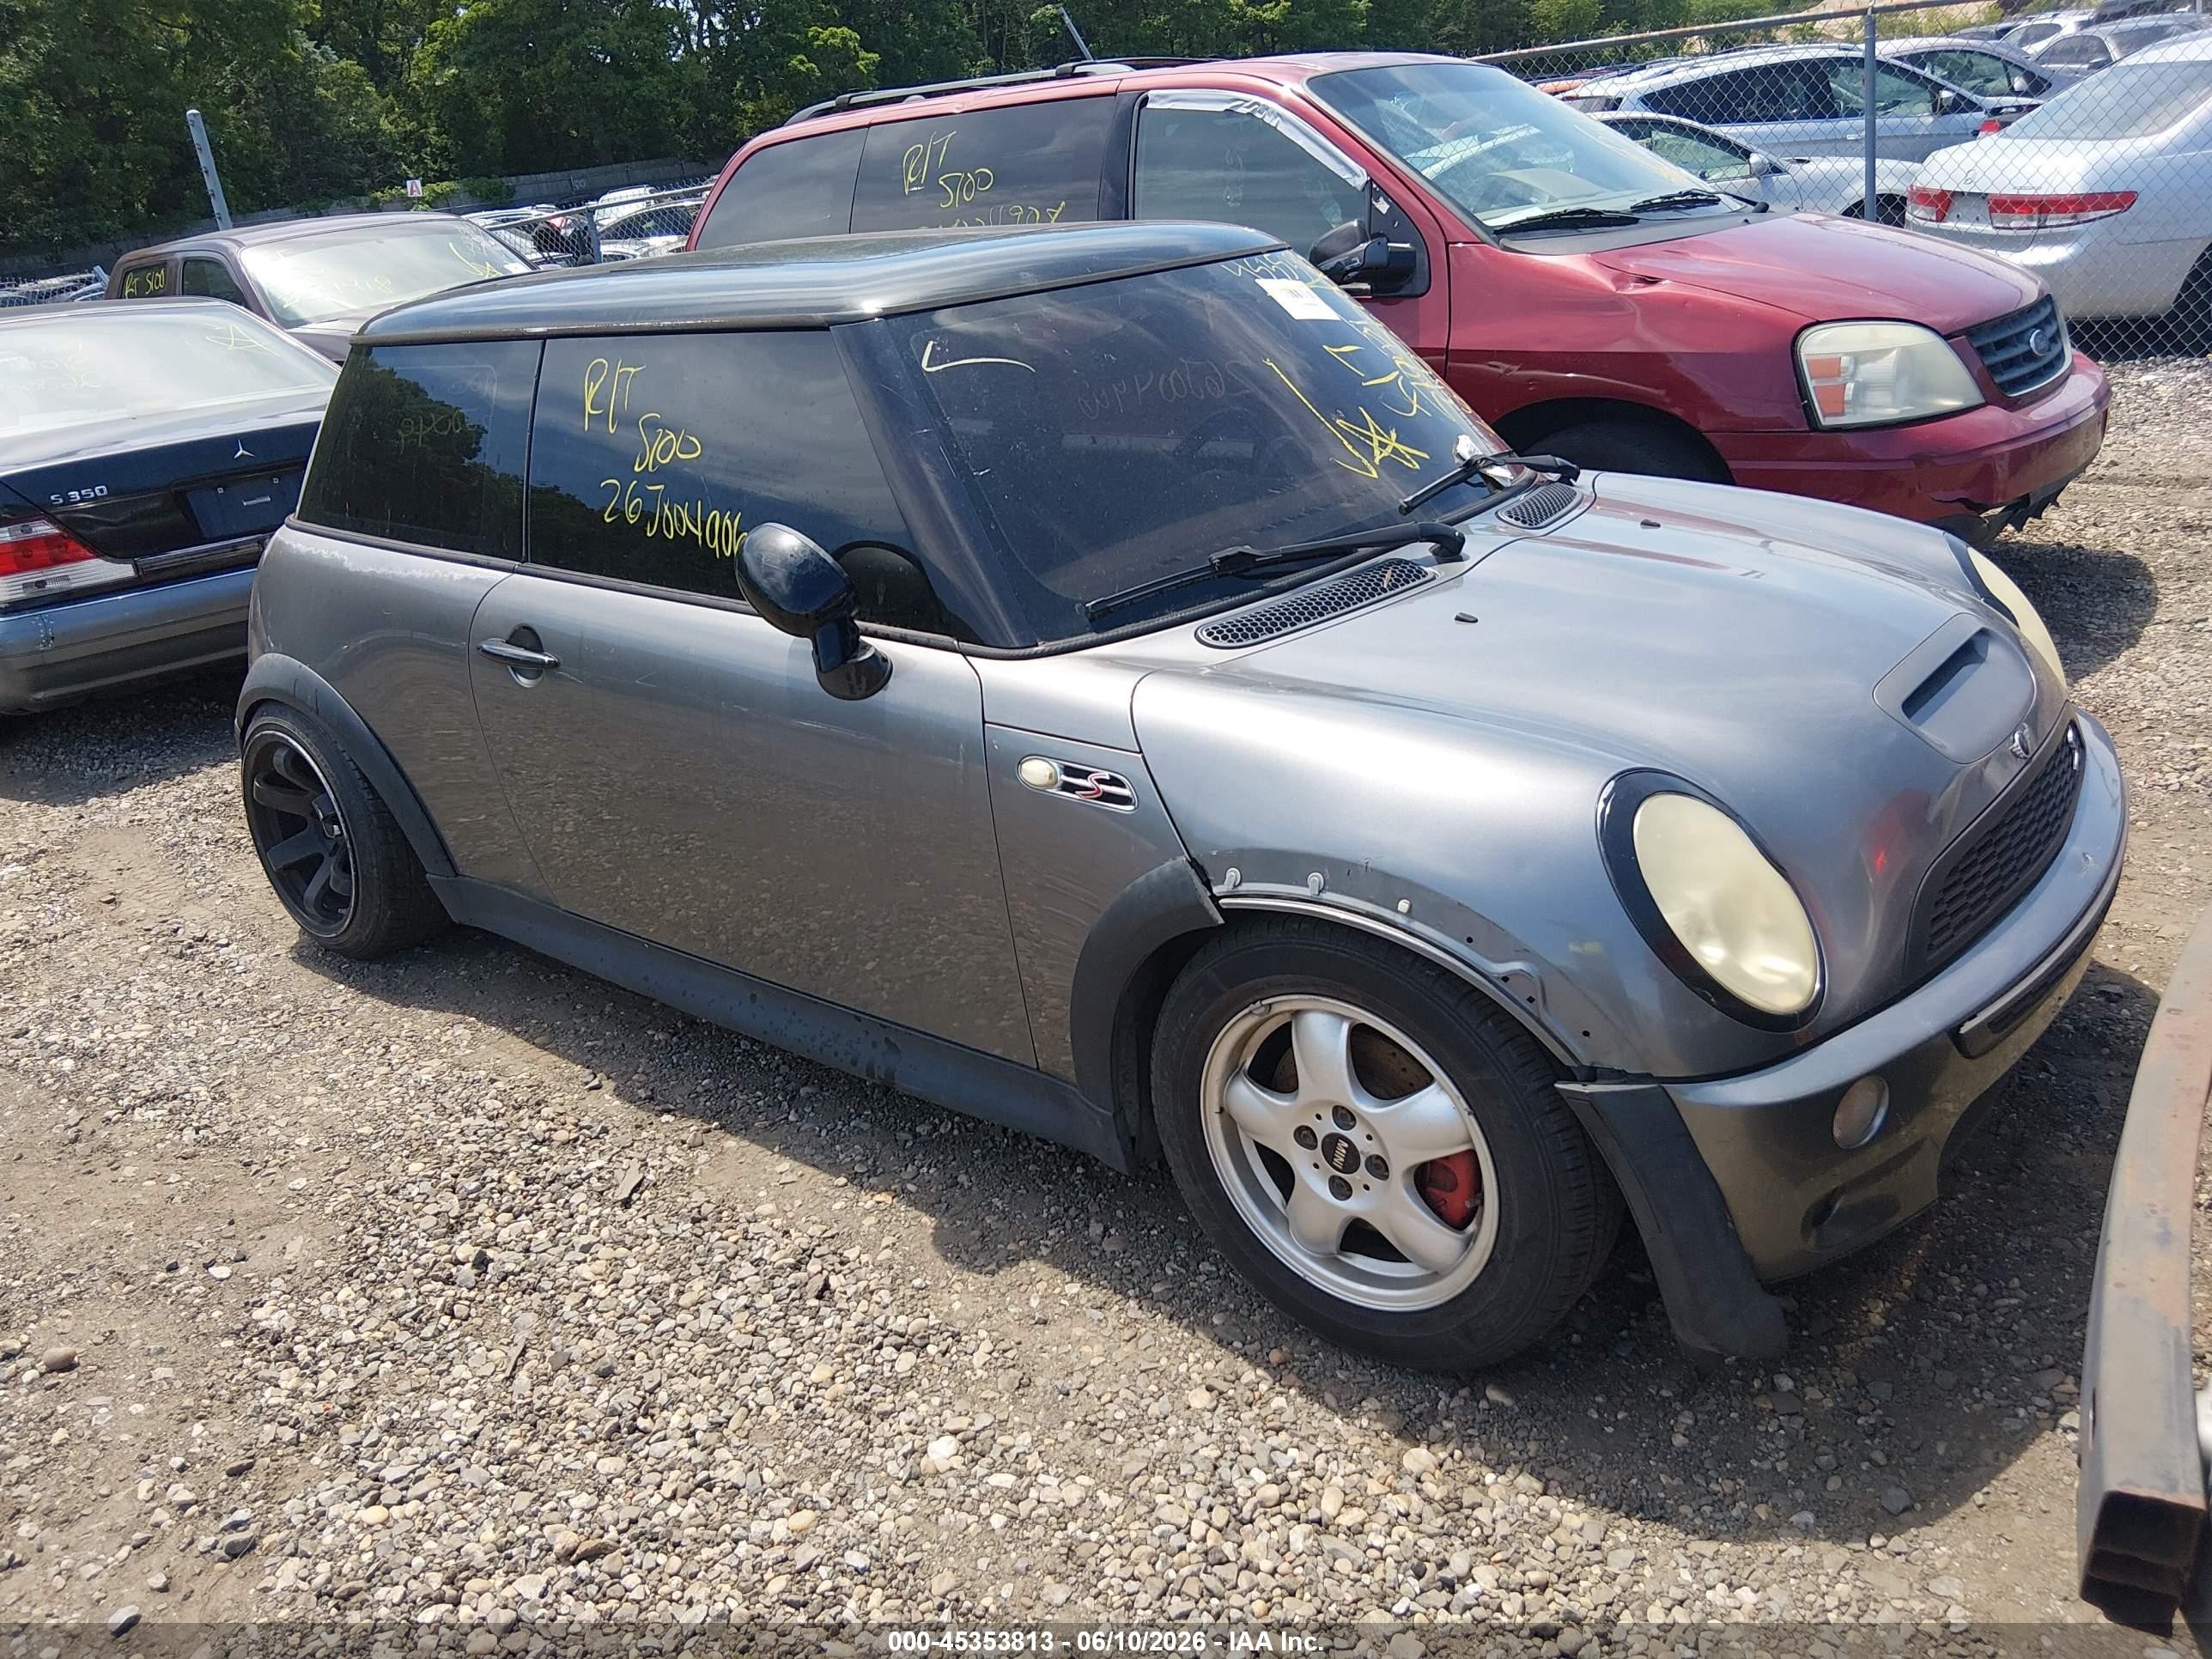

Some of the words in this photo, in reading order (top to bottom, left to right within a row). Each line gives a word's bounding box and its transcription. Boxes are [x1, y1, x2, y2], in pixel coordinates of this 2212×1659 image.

[408, 180, 421, 197] A
[50, 494, 64, 505] S
[67, 484, 108, 502] 350
[1074, 772, 1111, 799] S
[1332, 1138, 1349, 1170] MINI
